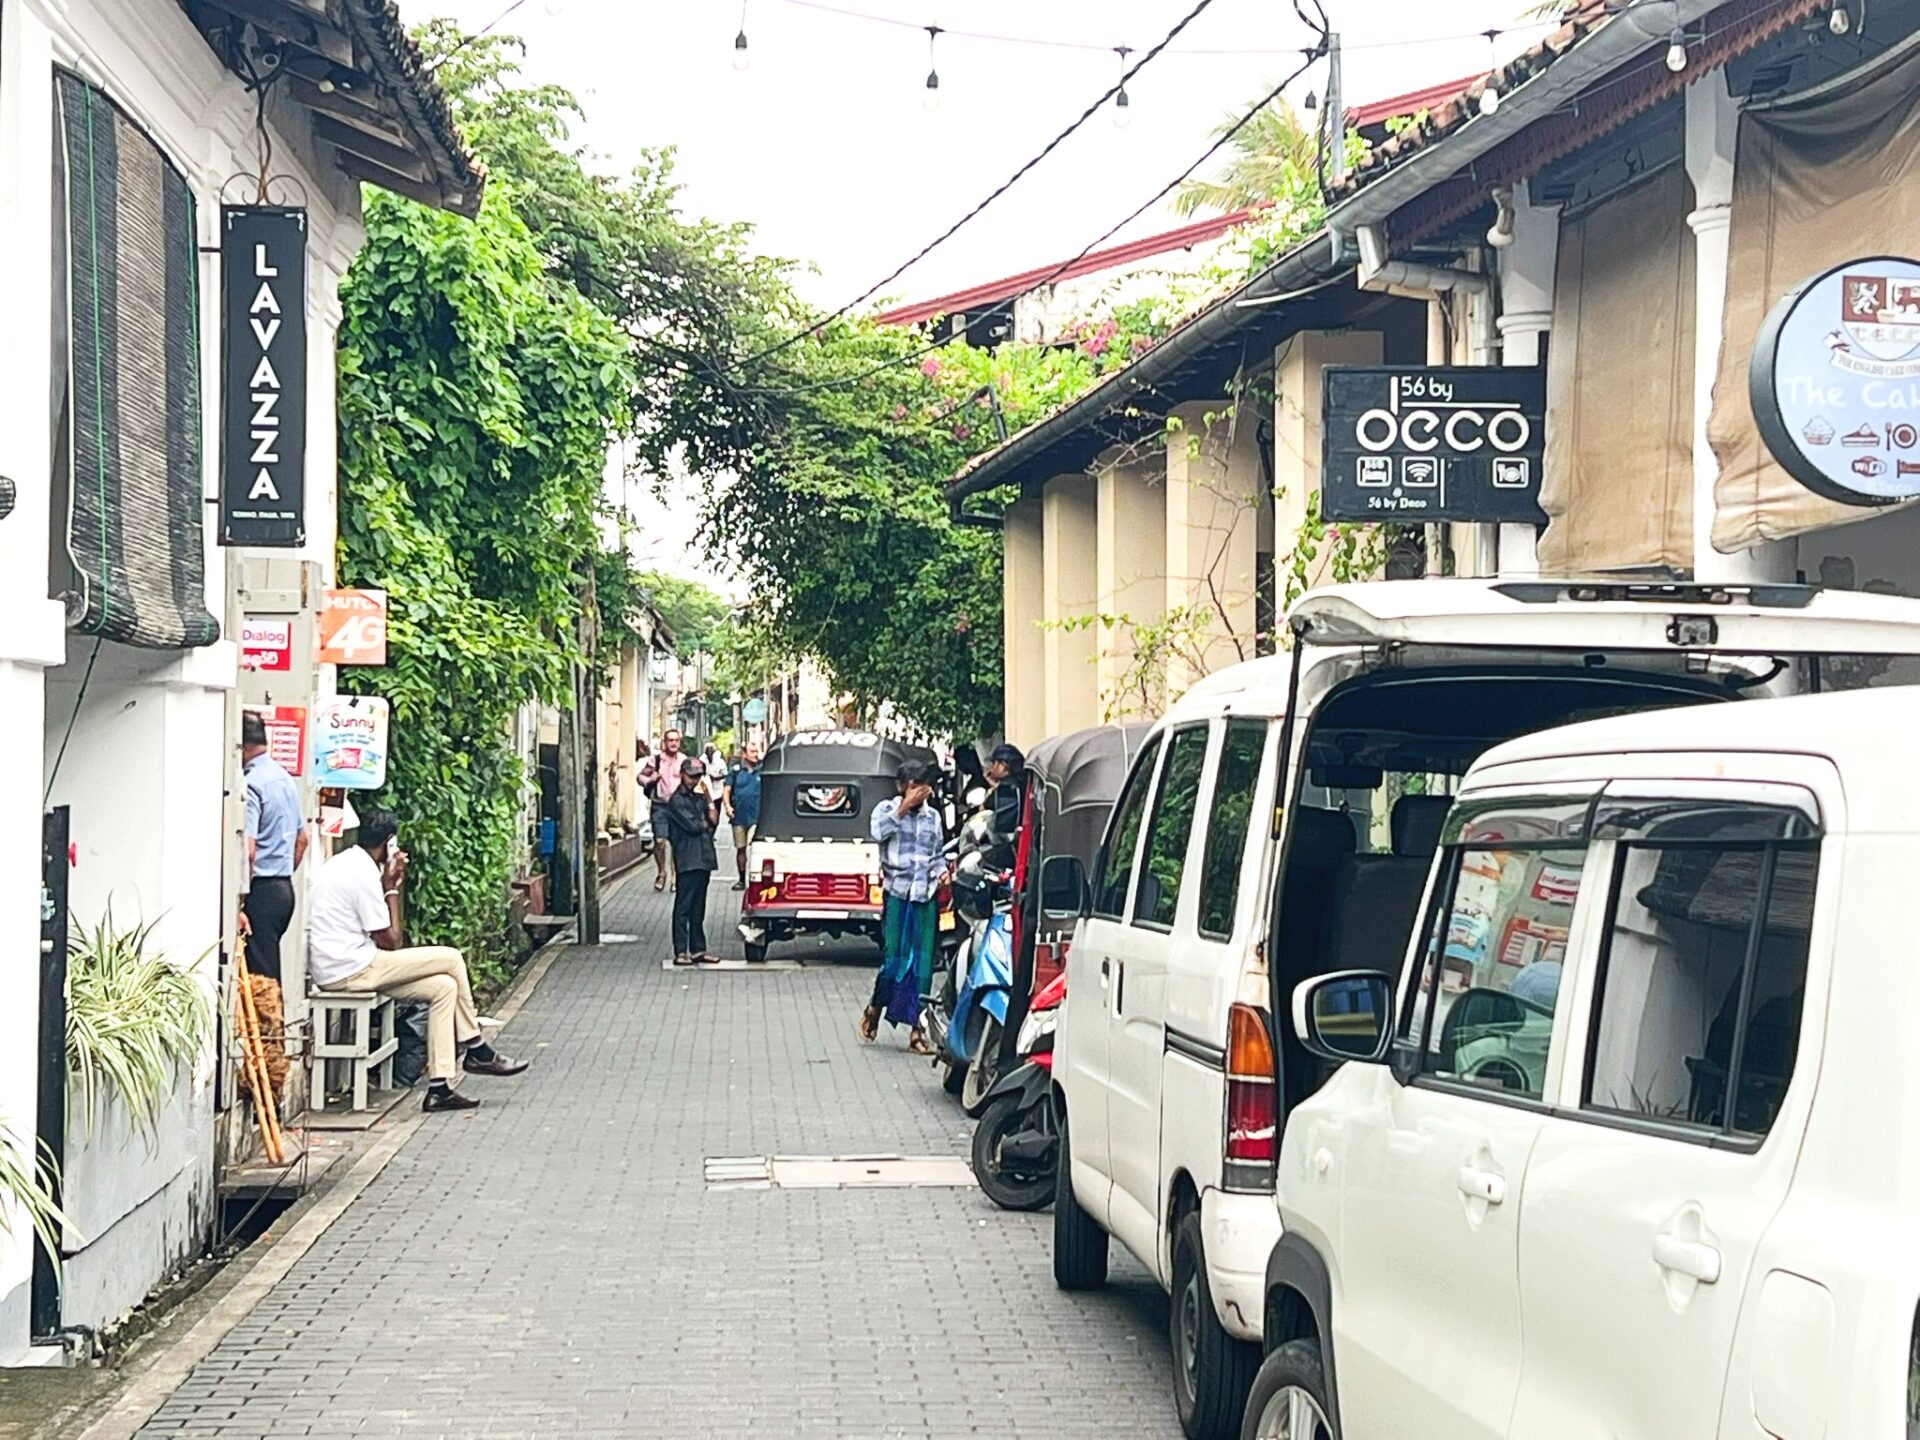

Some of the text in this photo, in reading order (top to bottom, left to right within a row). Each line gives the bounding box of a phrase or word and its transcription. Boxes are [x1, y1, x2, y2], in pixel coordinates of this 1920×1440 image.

[248, 243, 281, 501] LAVAZZA
[1401, 376, 1453, 401] 56 by
[1784, 374, 1847, 408] The
[1356, 376, 1530, 452] deco
[1368, 496, 1427, 511] 56 by Deco
[243, 629, 285, 644] Dialog
[327, 615, 384, 659] 4G
[330, 712, 376, 733] Sunny
[788, 731, 879, 748] KING
